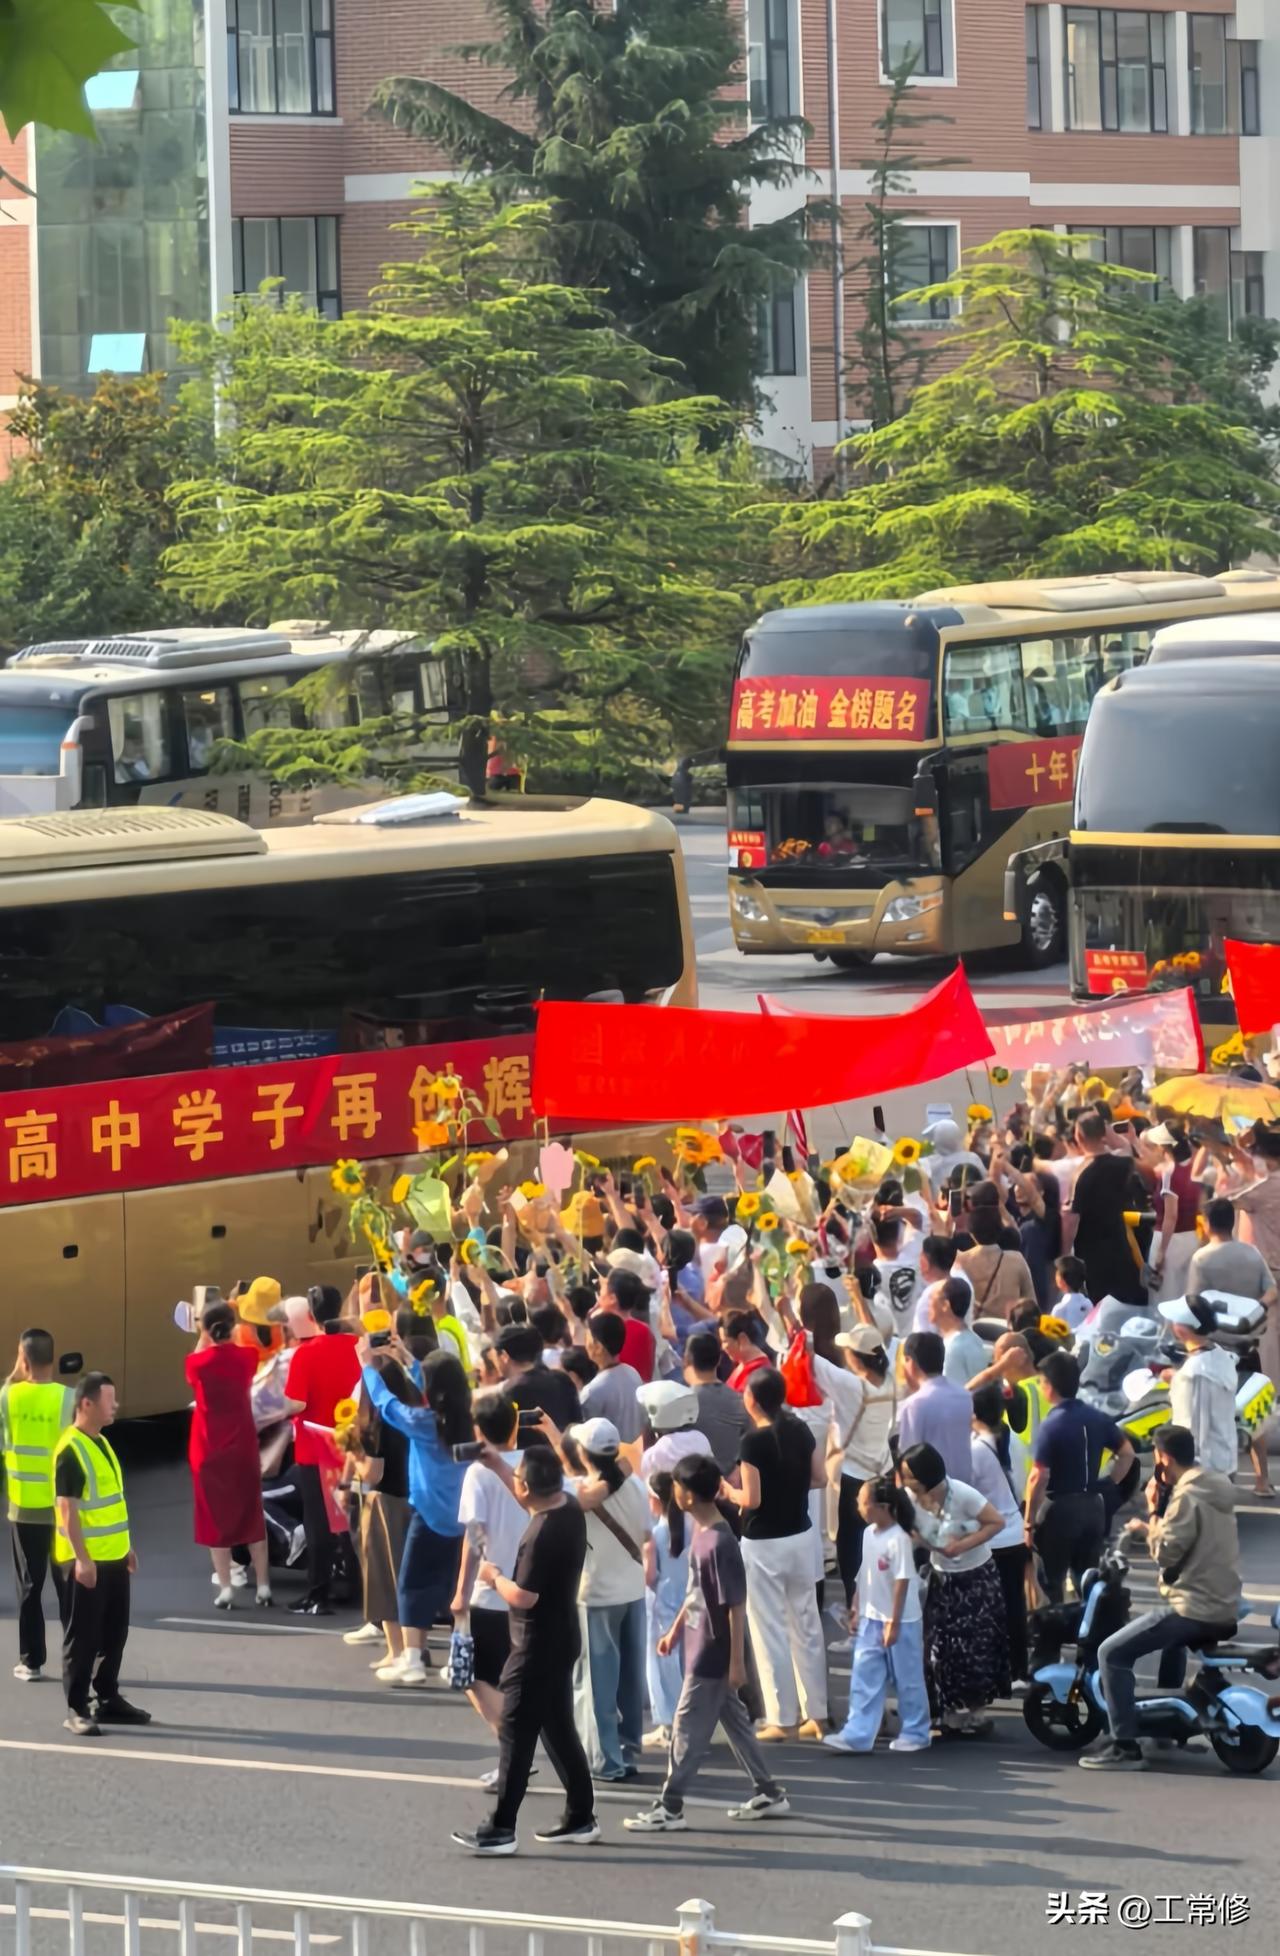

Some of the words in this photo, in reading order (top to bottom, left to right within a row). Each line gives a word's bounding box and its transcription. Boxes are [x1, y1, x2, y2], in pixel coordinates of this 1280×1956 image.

[736, 688, 819, 730] 高考加油
[827, 688, 917, 732] 金榜题名
[1025, 748, 1079, 793] 十年
